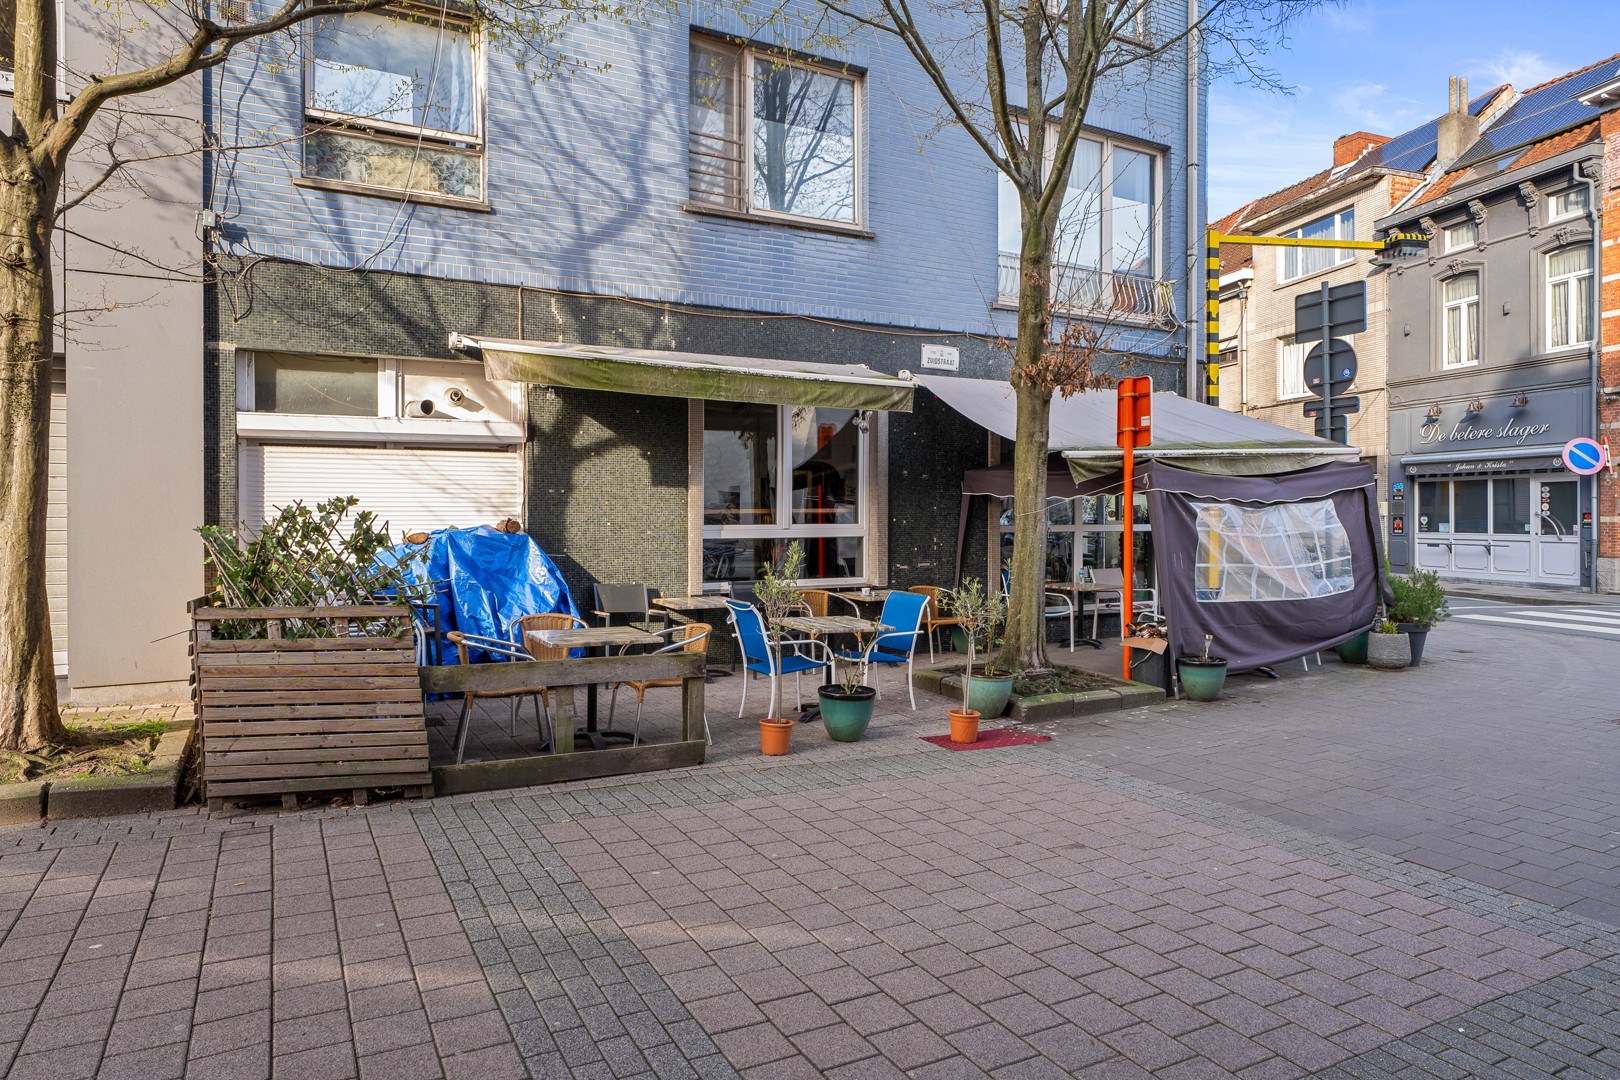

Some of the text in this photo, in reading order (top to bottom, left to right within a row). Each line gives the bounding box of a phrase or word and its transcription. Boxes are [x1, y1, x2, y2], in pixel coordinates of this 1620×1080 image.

[926, 356, 954, 366] ZUIDSTRAAT
[1420, 418, 1550, 445] De betere slager
